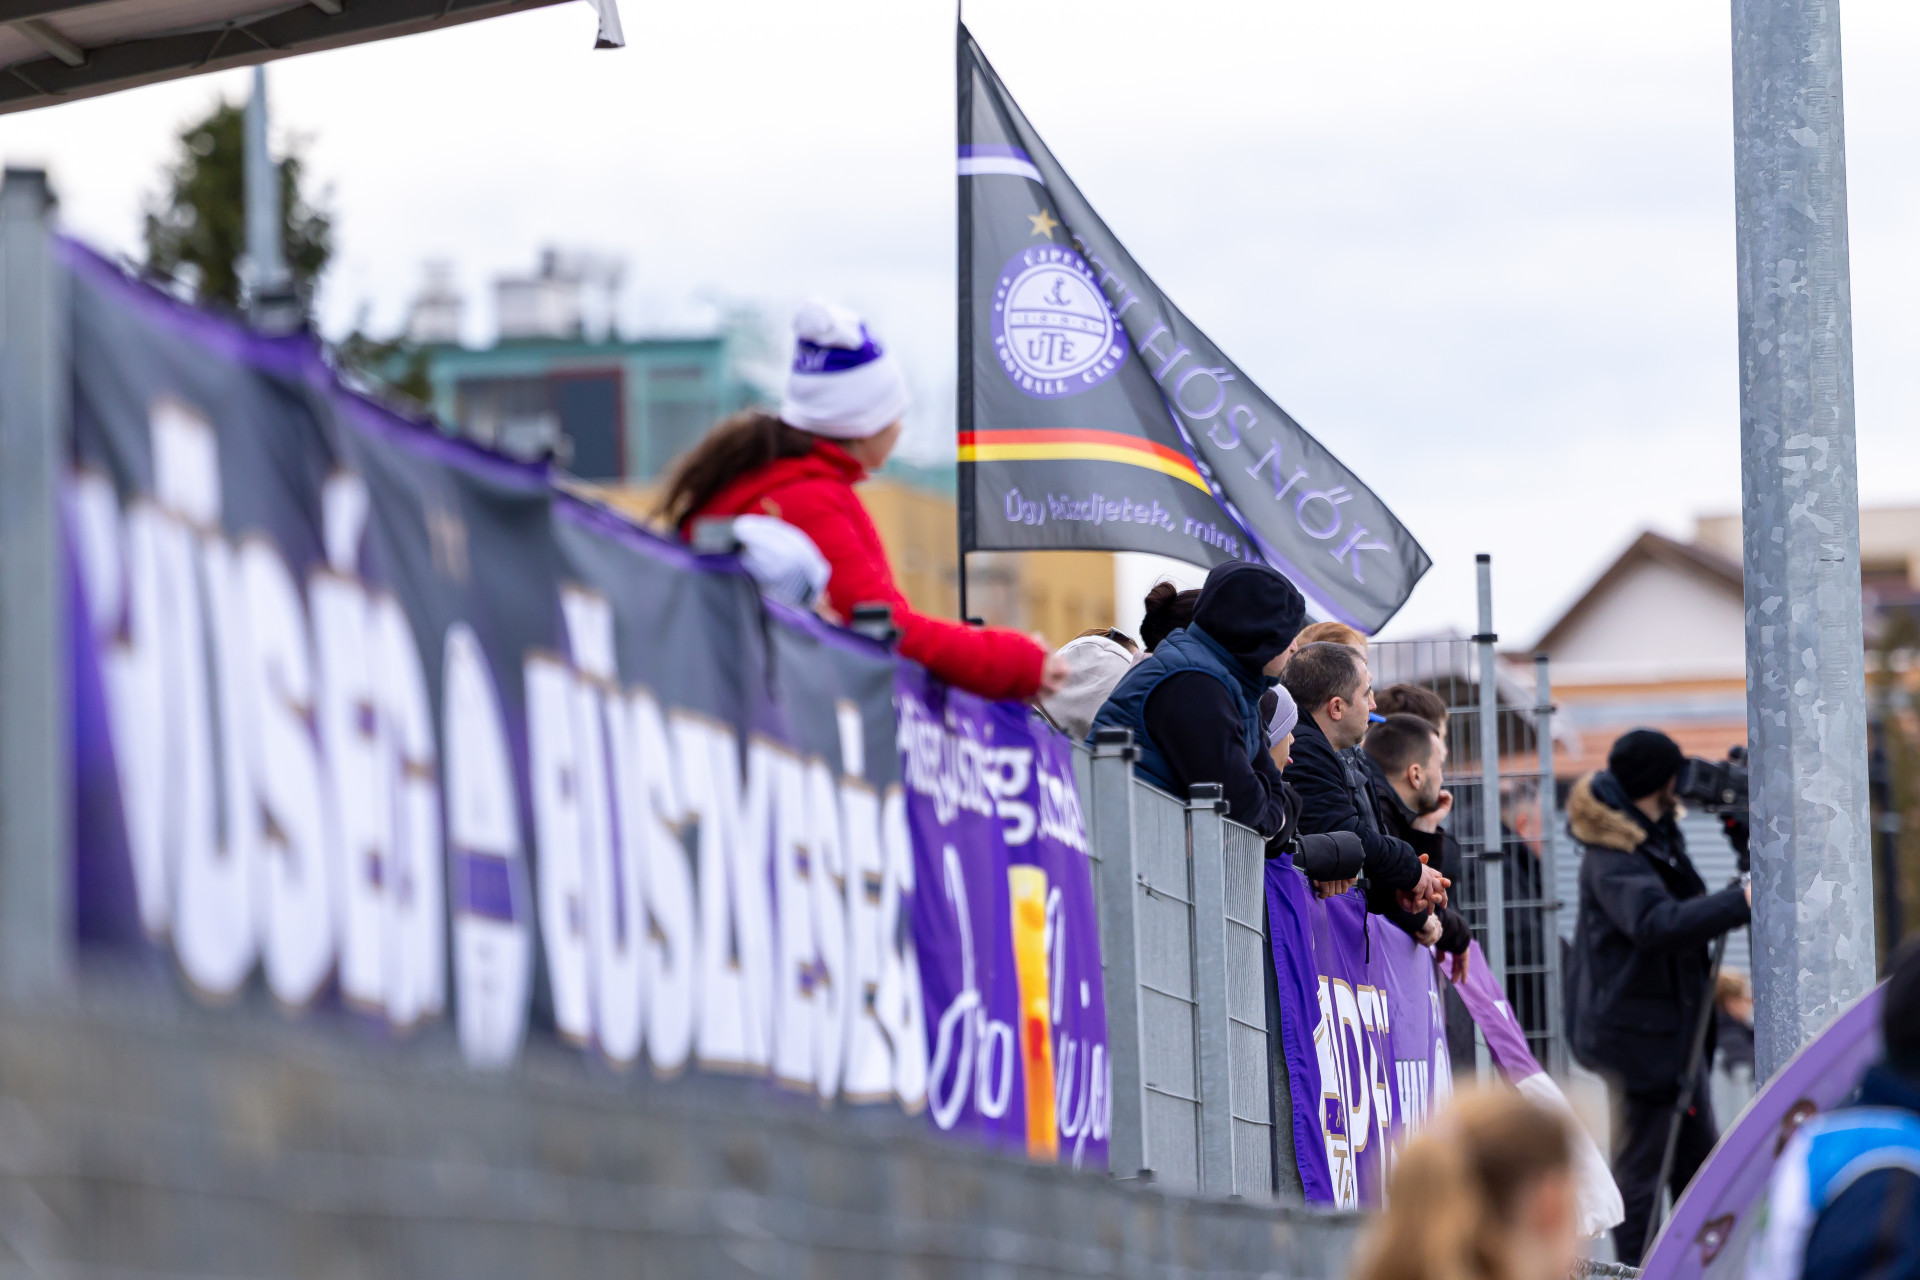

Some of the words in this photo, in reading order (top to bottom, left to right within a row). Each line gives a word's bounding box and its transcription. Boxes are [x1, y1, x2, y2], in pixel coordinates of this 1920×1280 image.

[1028, 332, 1077, 366] UTE
[1081, 344, 1124, 384] CLUB
[1004, 487, 1047, 526] Úgy
[1182, 516, 1240, 559] mint
